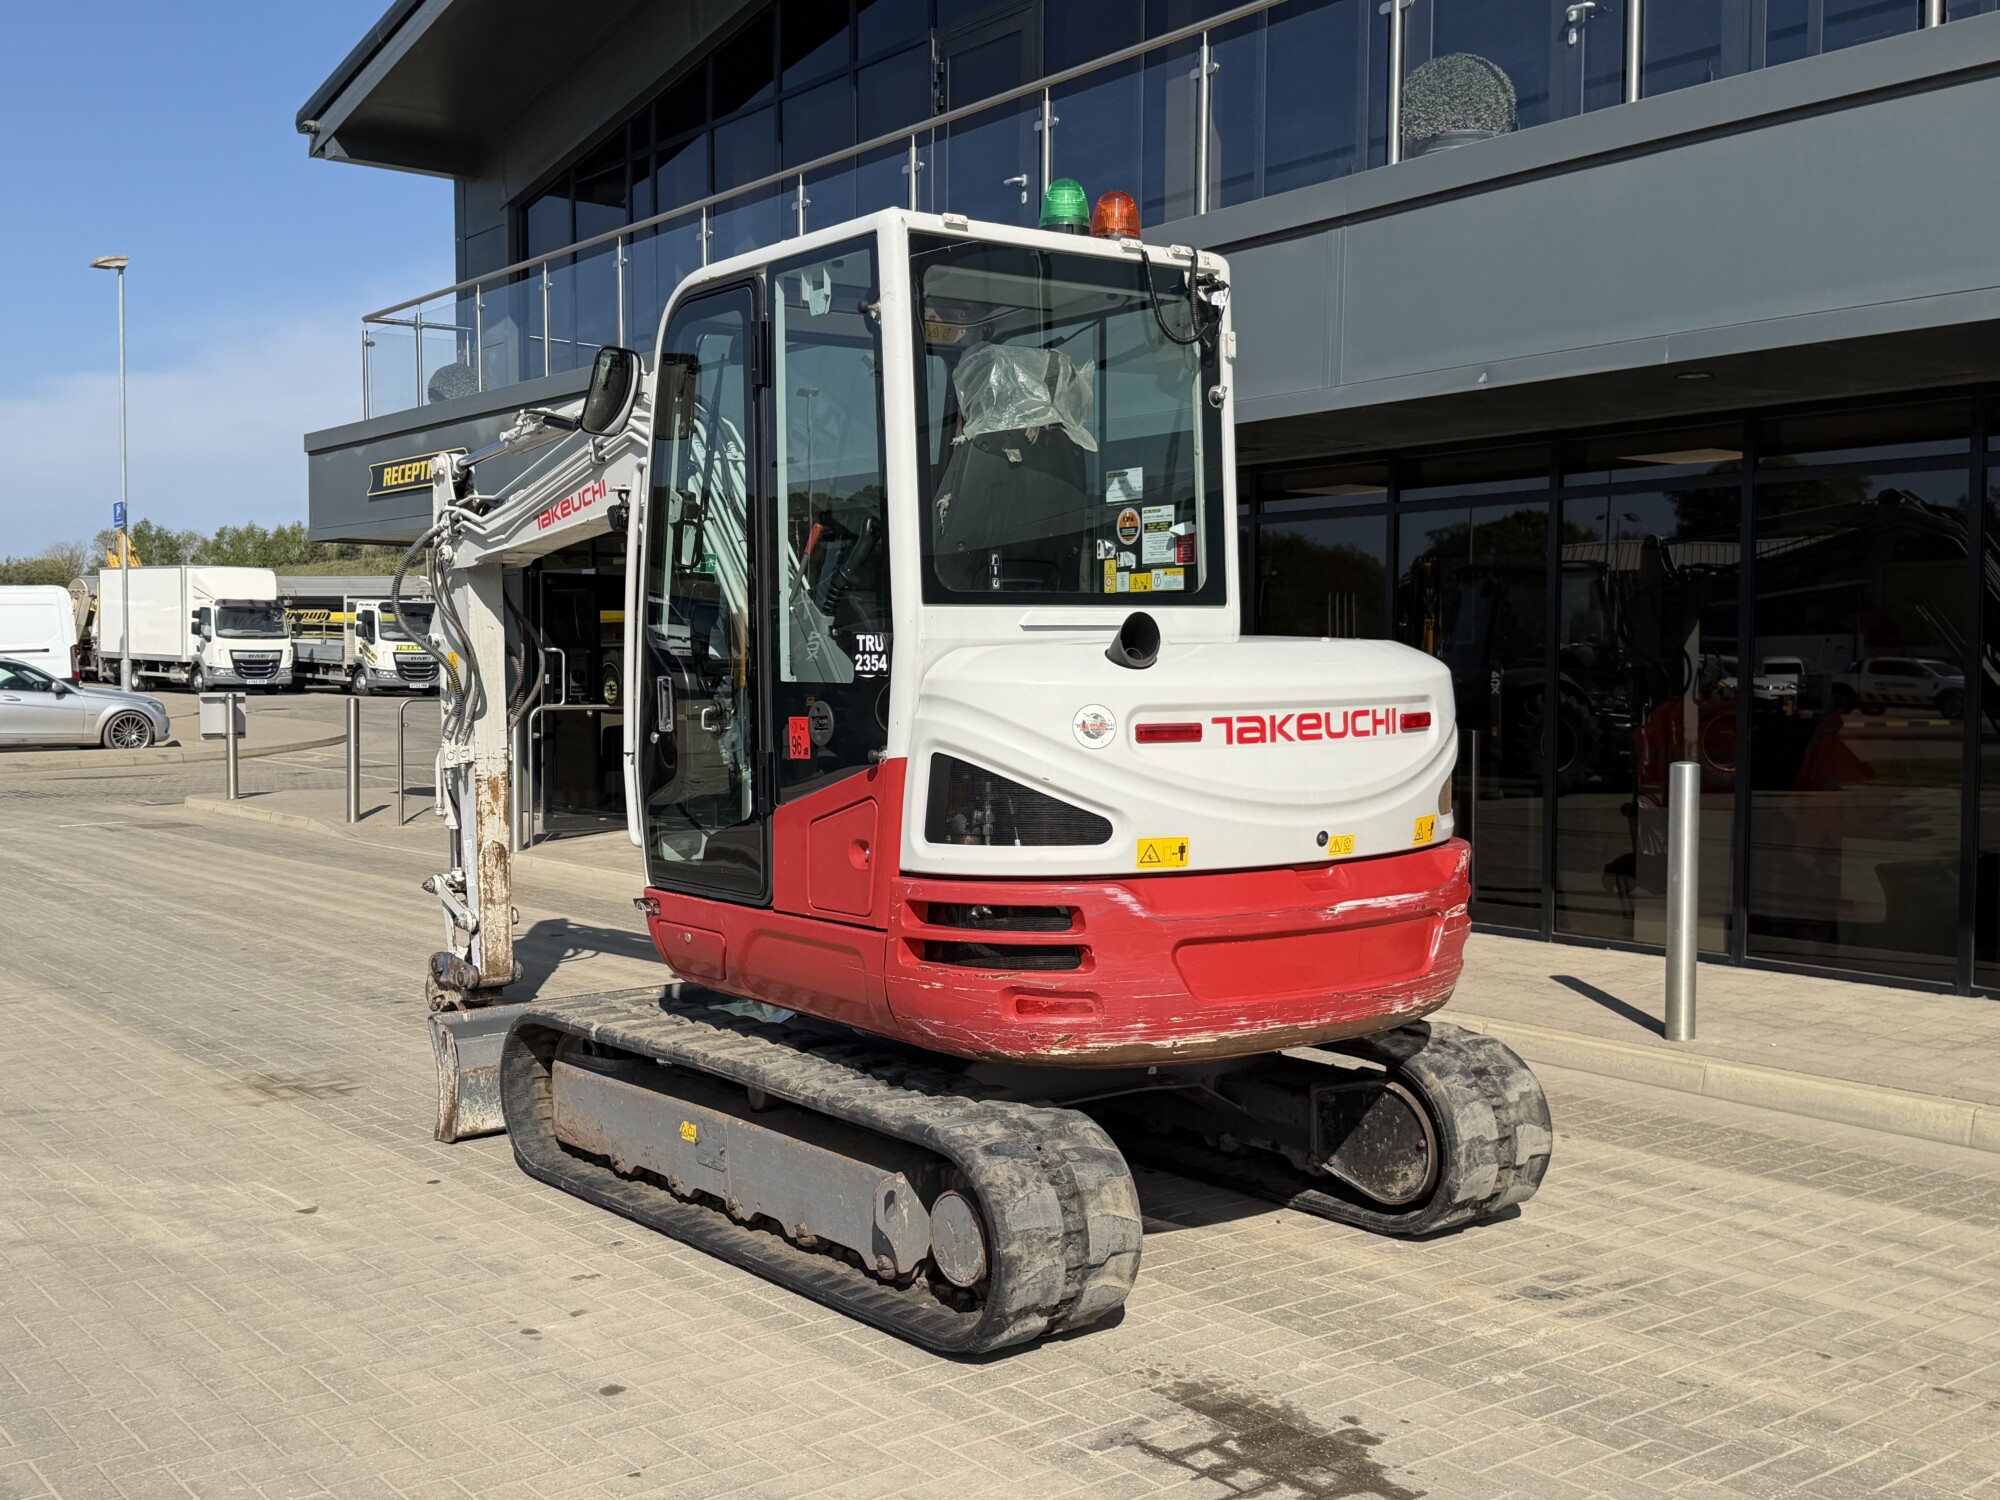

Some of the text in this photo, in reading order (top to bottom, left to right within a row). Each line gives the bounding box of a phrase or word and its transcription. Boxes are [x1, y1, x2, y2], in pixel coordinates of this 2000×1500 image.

[382, 460, 432, 487] RECEPTI
[532, 479, 607, 531] TAKEUCHI
[856, 634, 885, 652] TRU
[855, 654, 888, 671] 2354
[1211, 707, 1397, 745] TAKEUCHI
[791, 735, 802, 755] 96
